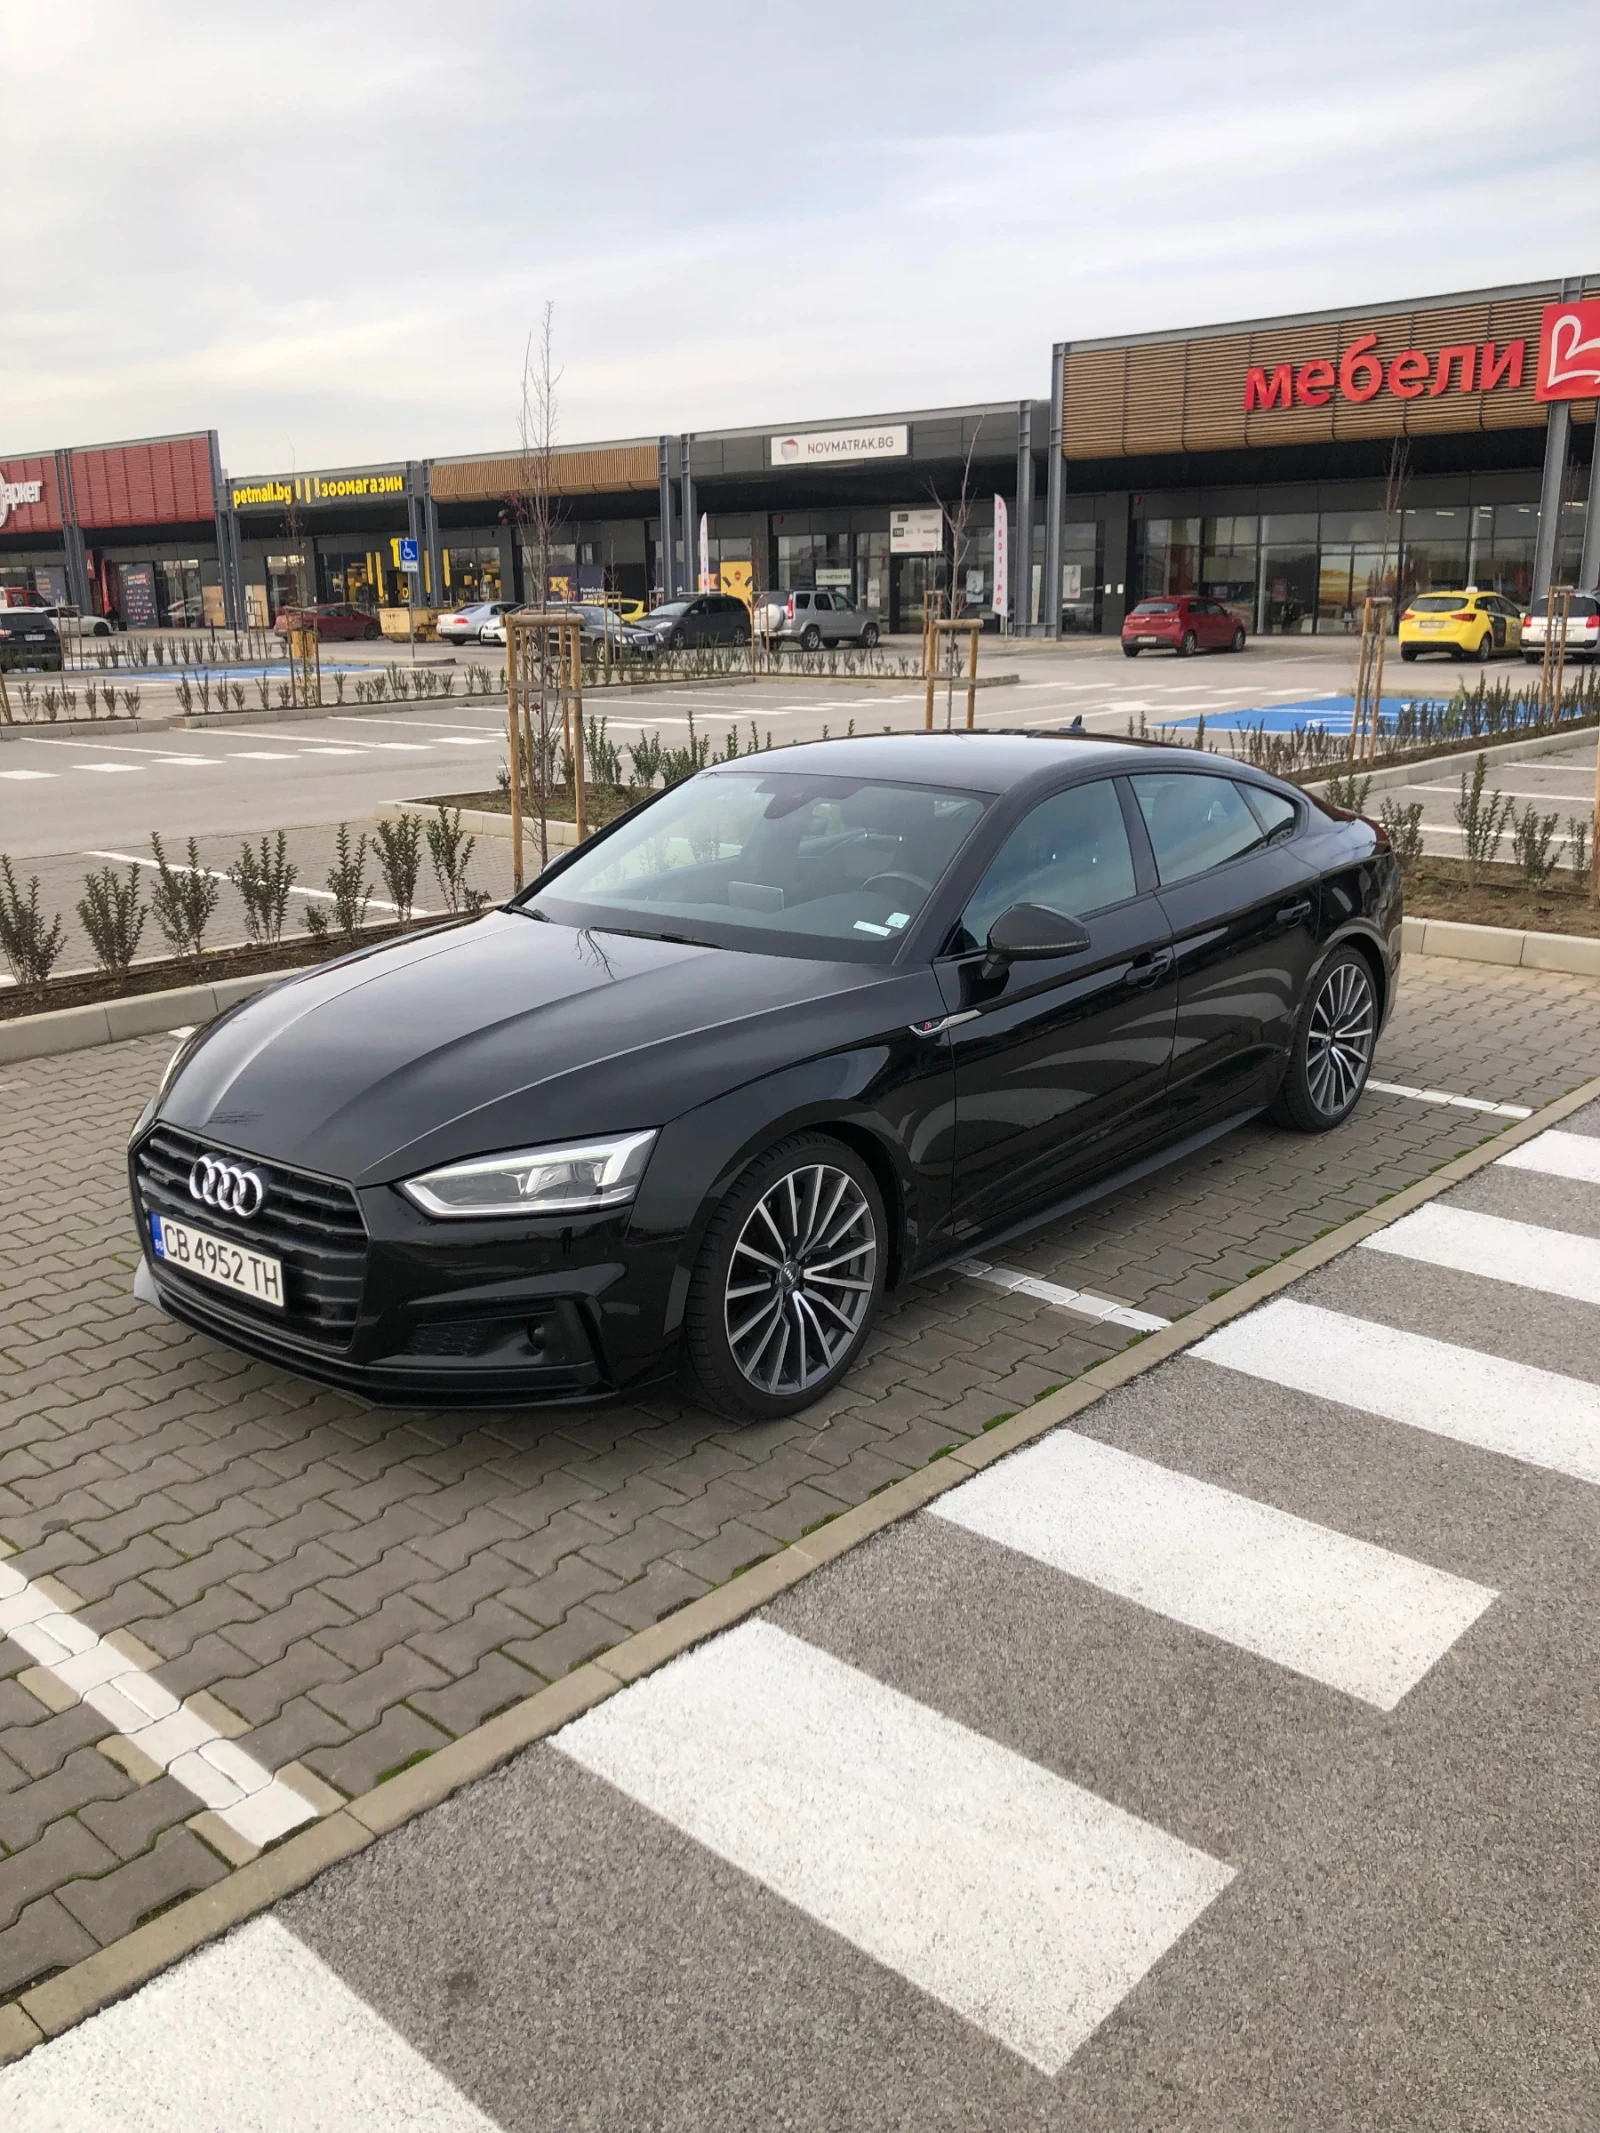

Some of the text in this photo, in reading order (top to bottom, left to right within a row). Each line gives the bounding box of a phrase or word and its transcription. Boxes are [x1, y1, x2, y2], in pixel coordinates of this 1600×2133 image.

[1244, 332, 1525, 410] мебели
[808, 436, 894, 454] NOVMATRAK.BG
[233, 476, 403, 508] petmall.bg зоомагазин
[164, 1224, 279, 1299] CB 4952 TH
